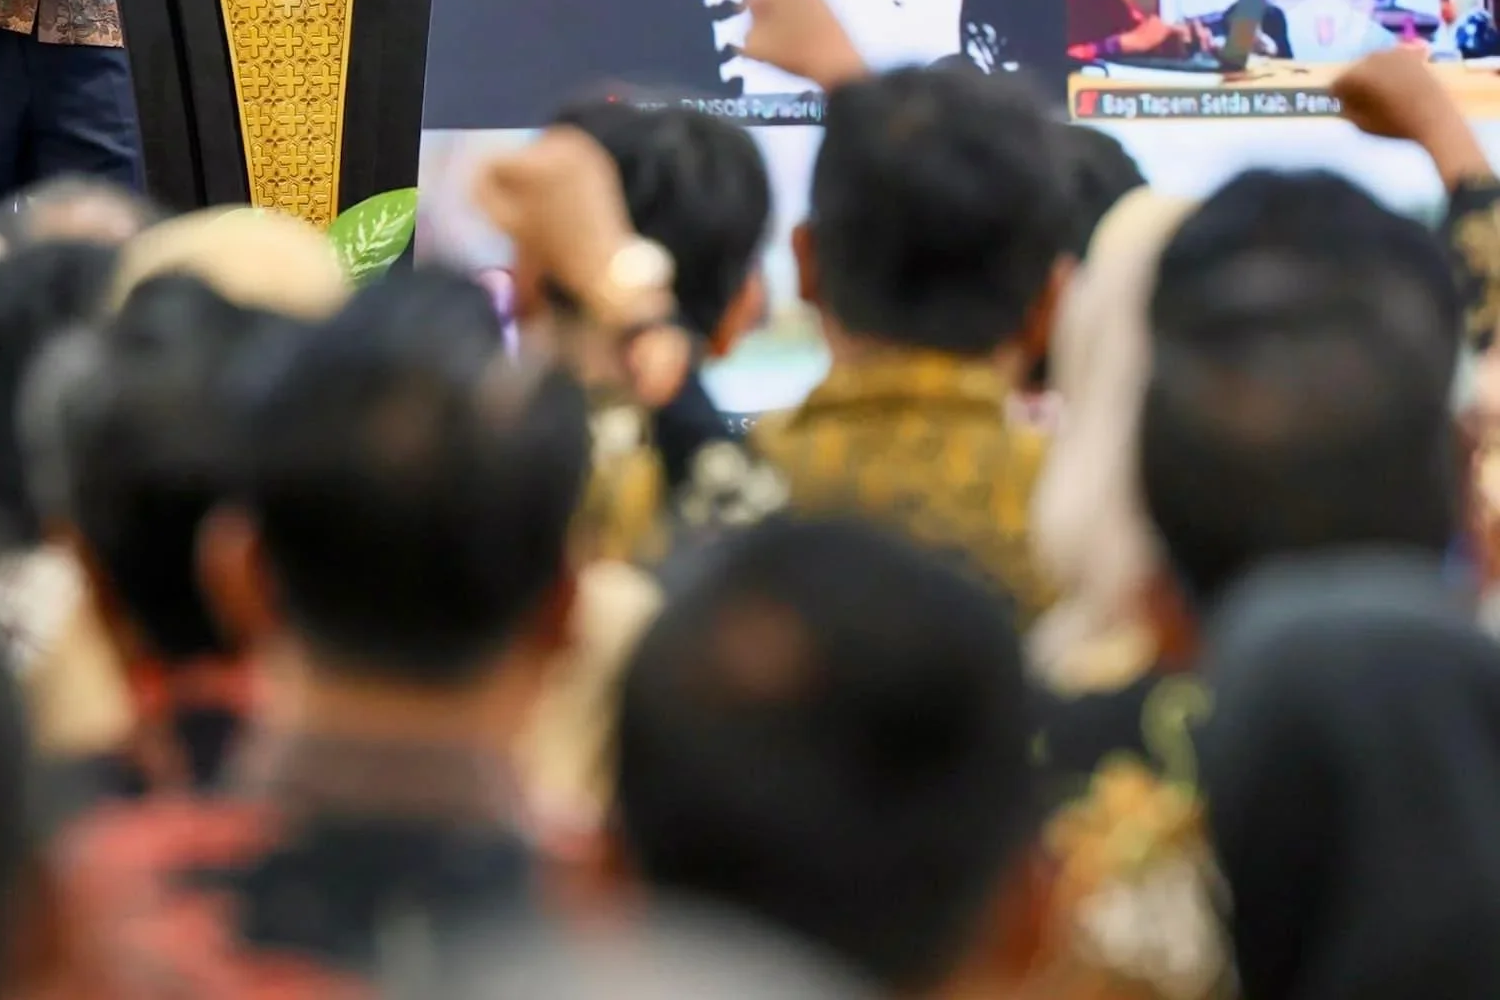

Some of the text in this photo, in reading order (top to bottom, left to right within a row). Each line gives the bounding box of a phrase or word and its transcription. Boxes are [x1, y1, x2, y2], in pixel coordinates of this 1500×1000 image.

[1102, 92, 1138, 119] Bag
[1140, 93, 1198, 116] Tapem
[1200, 92, 1250, 115] Setda
[1295, 92, 1342, 113] Pema
